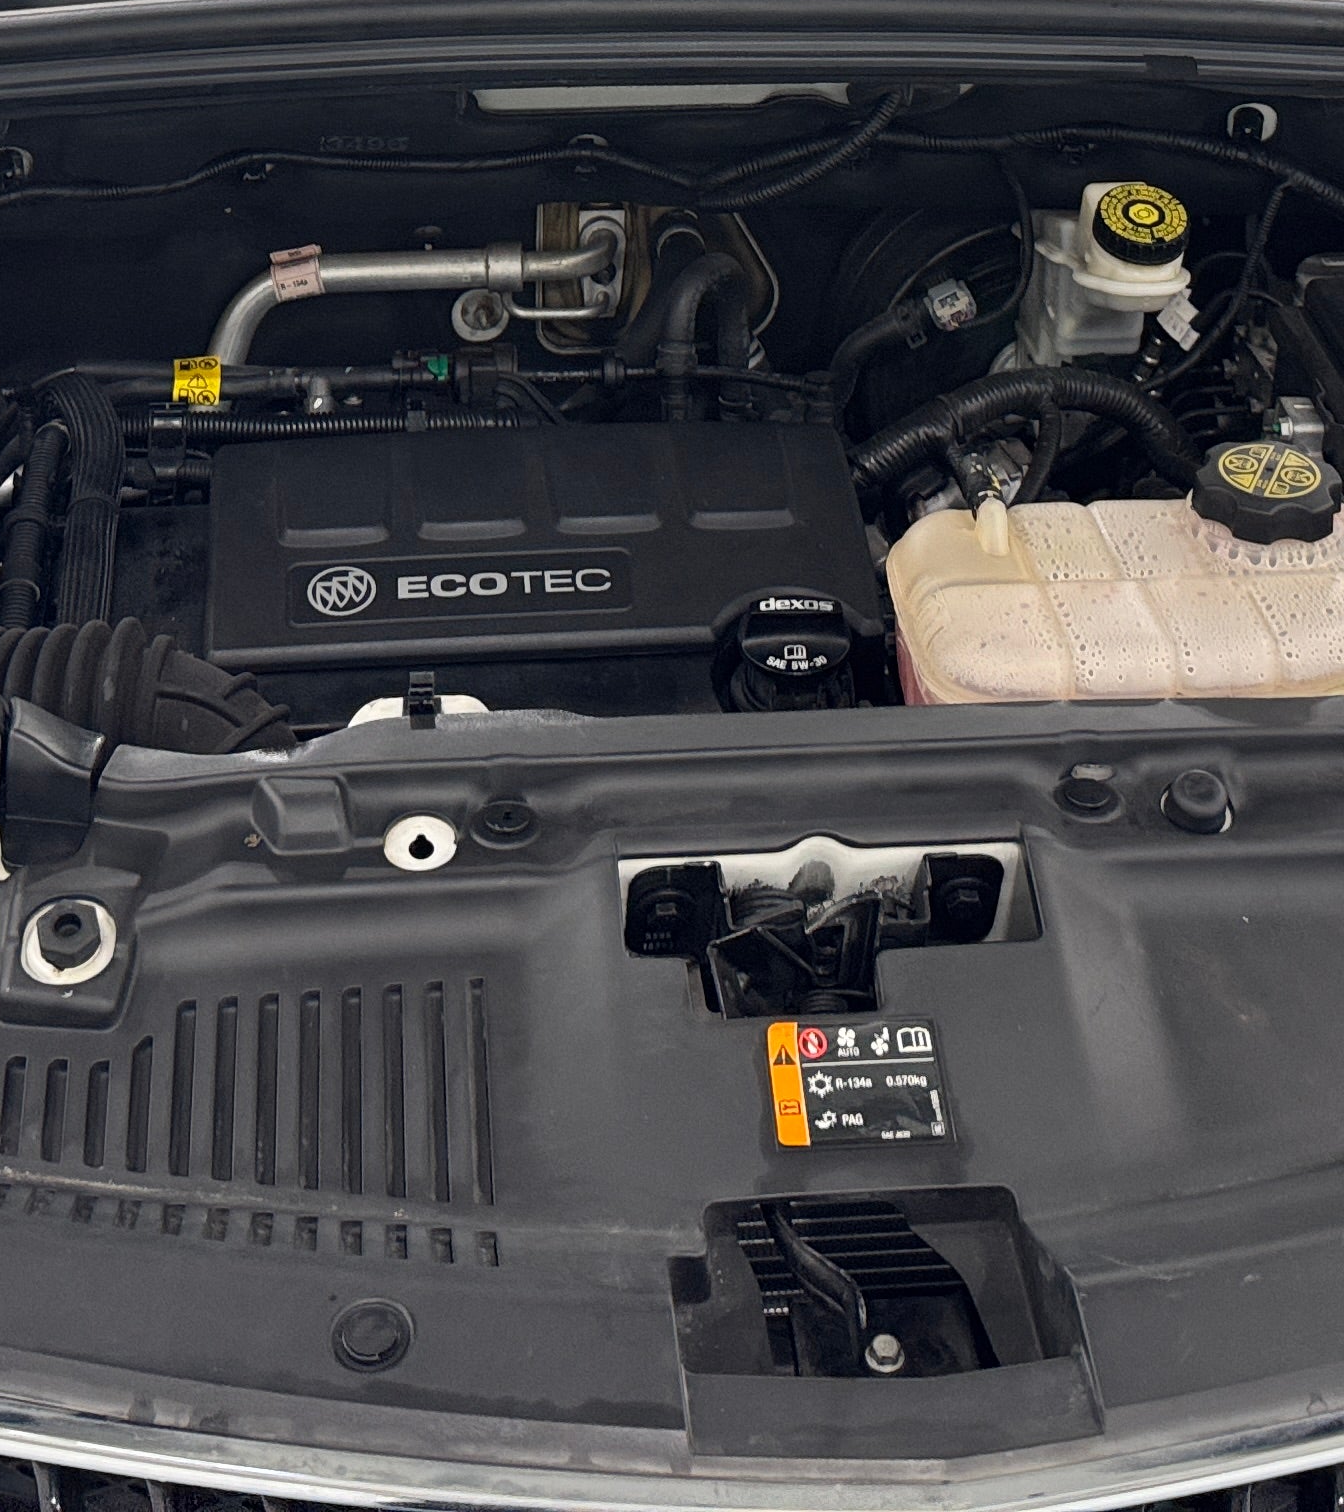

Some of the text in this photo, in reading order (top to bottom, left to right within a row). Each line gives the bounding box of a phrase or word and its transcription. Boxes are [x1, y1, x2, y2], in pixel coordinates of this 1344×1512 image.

[397, 568, 612, 599] ECOTEC
[759, 597, 834, 612] dexos
[766, 655, 828, 670] SAE 5W-30
[837, 1046, 860, 1057] AUTO
[835, 1076, 873, 1090] R-134a
[841, 1112, 864, 1126] PAG
